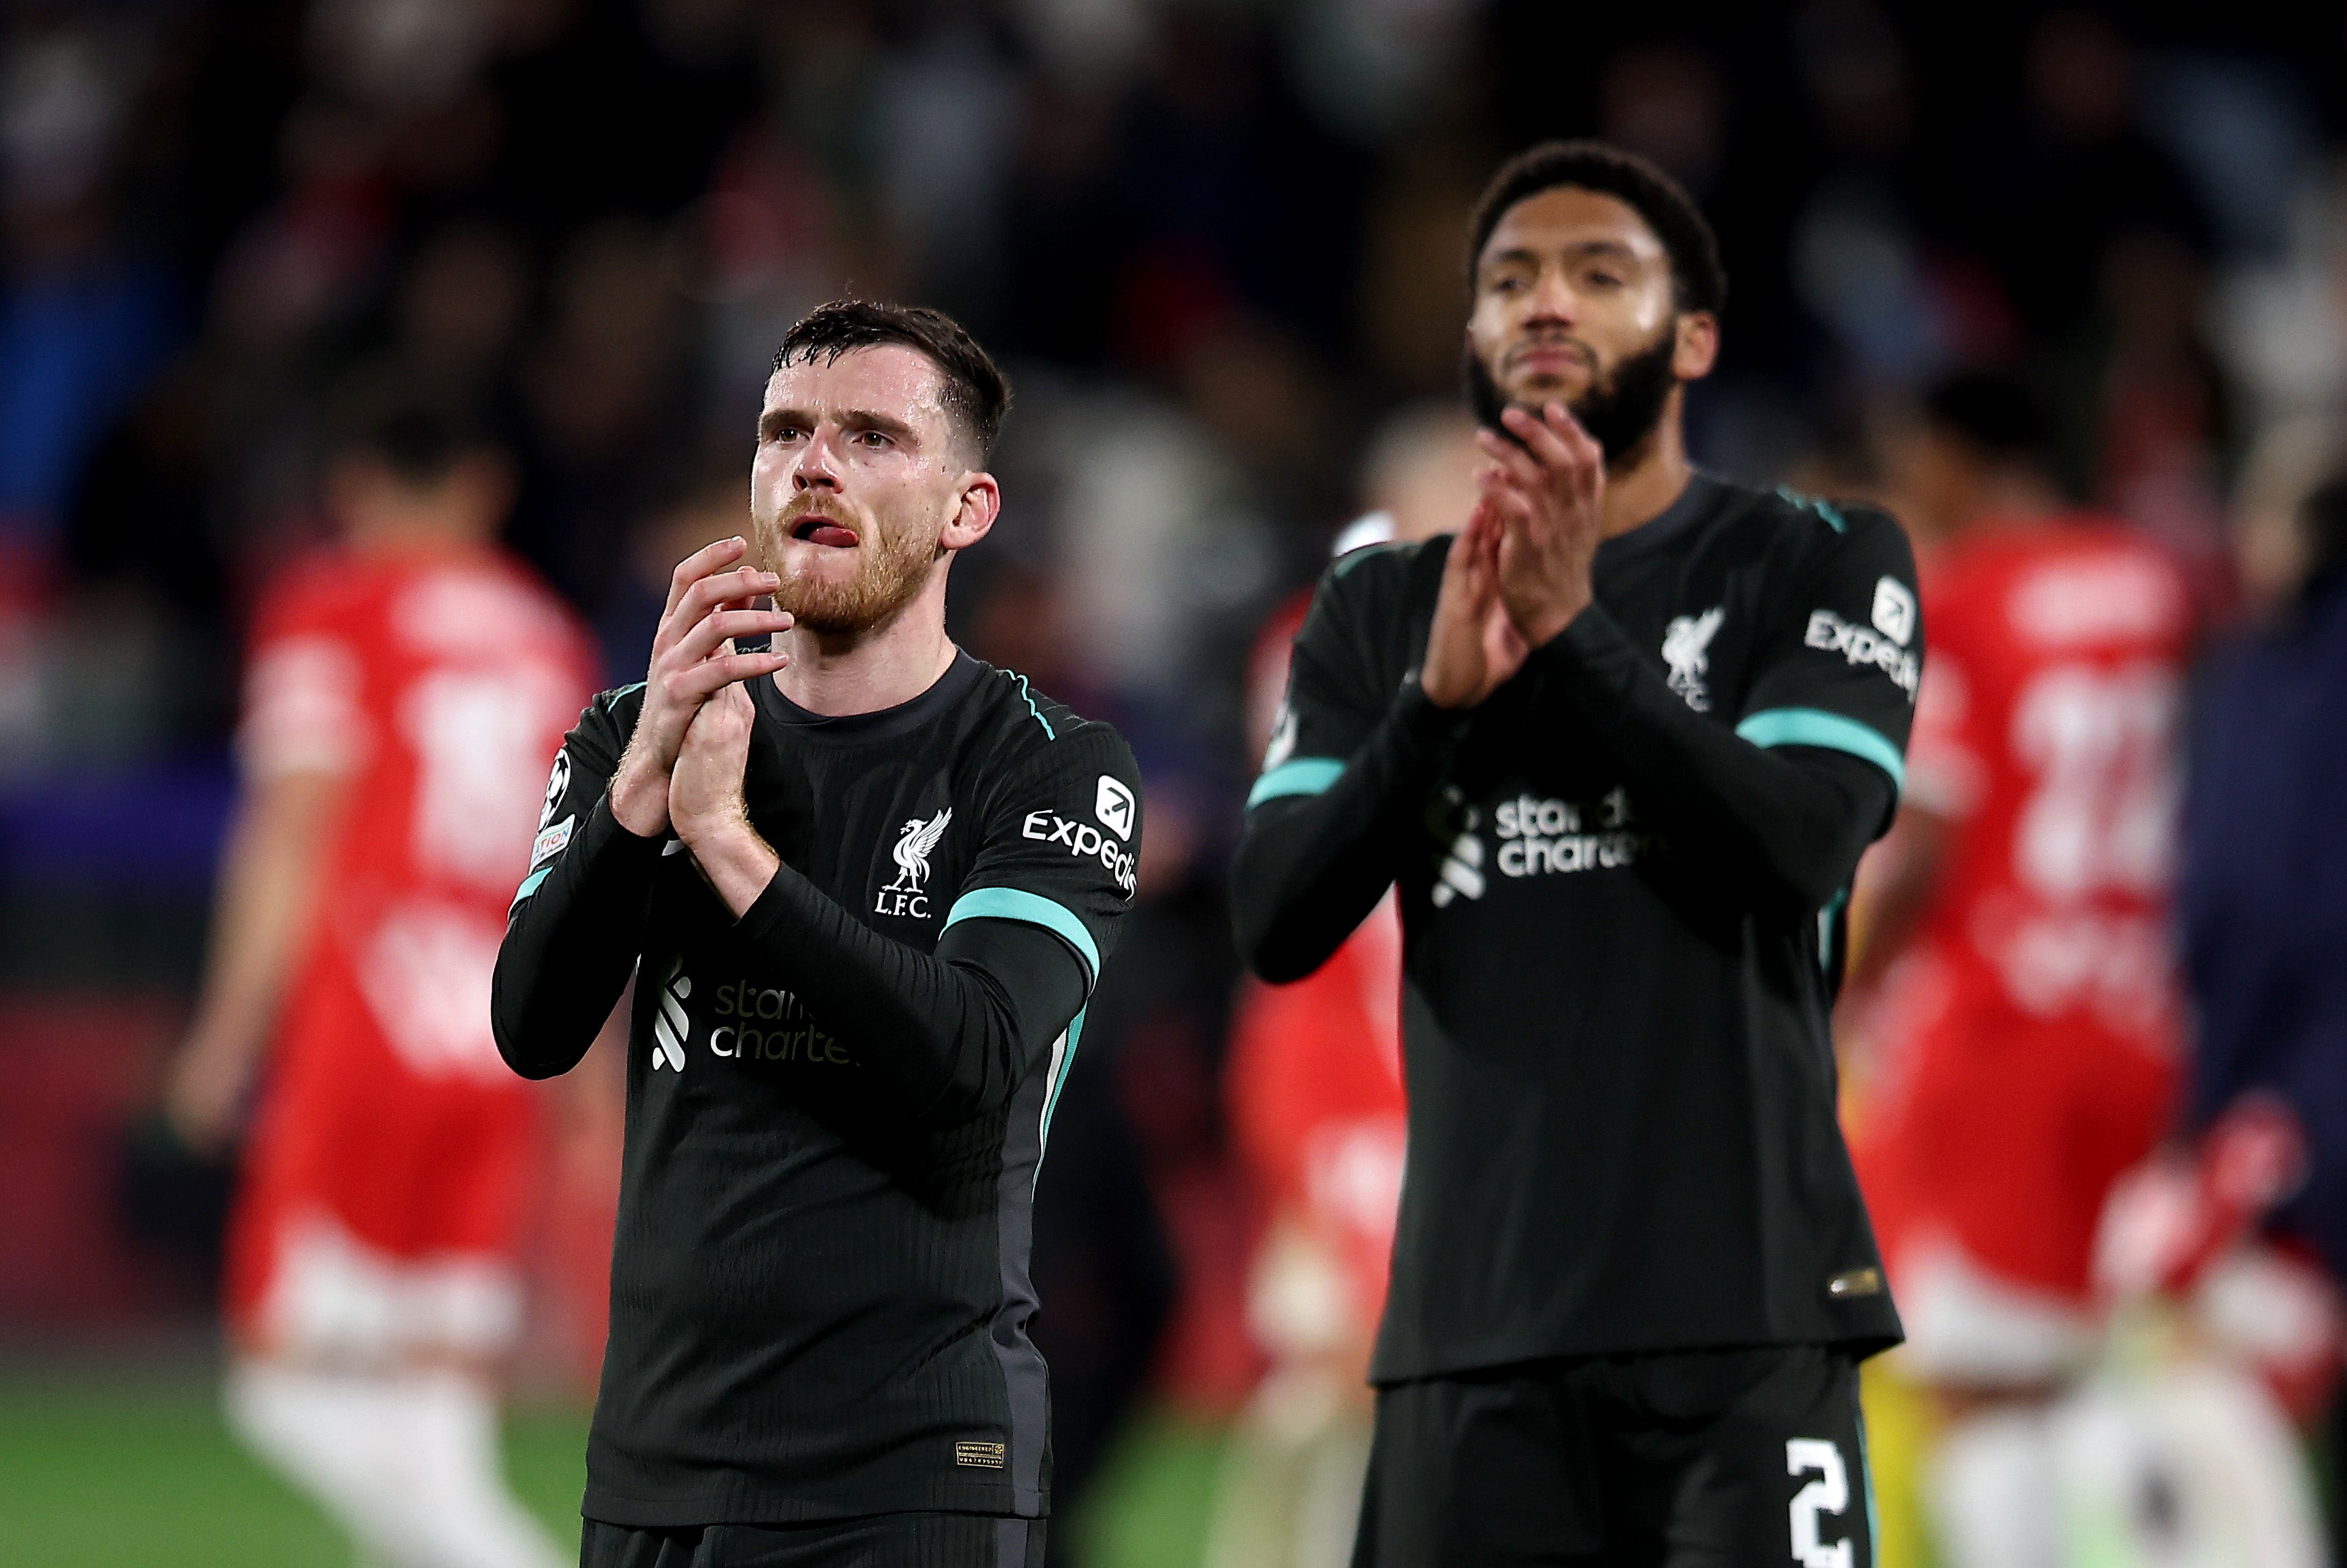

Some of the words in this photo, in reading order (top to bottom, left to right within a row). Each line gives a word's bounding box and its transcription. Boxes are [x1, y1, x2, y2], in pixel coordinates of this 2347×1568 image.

[875, 891, 932, 919] L.F.C.
[714, 979, 814, 1020] stan
[710, 1021, 860, 1067] charte
[1785, 1436, 1855, 1568] 2
